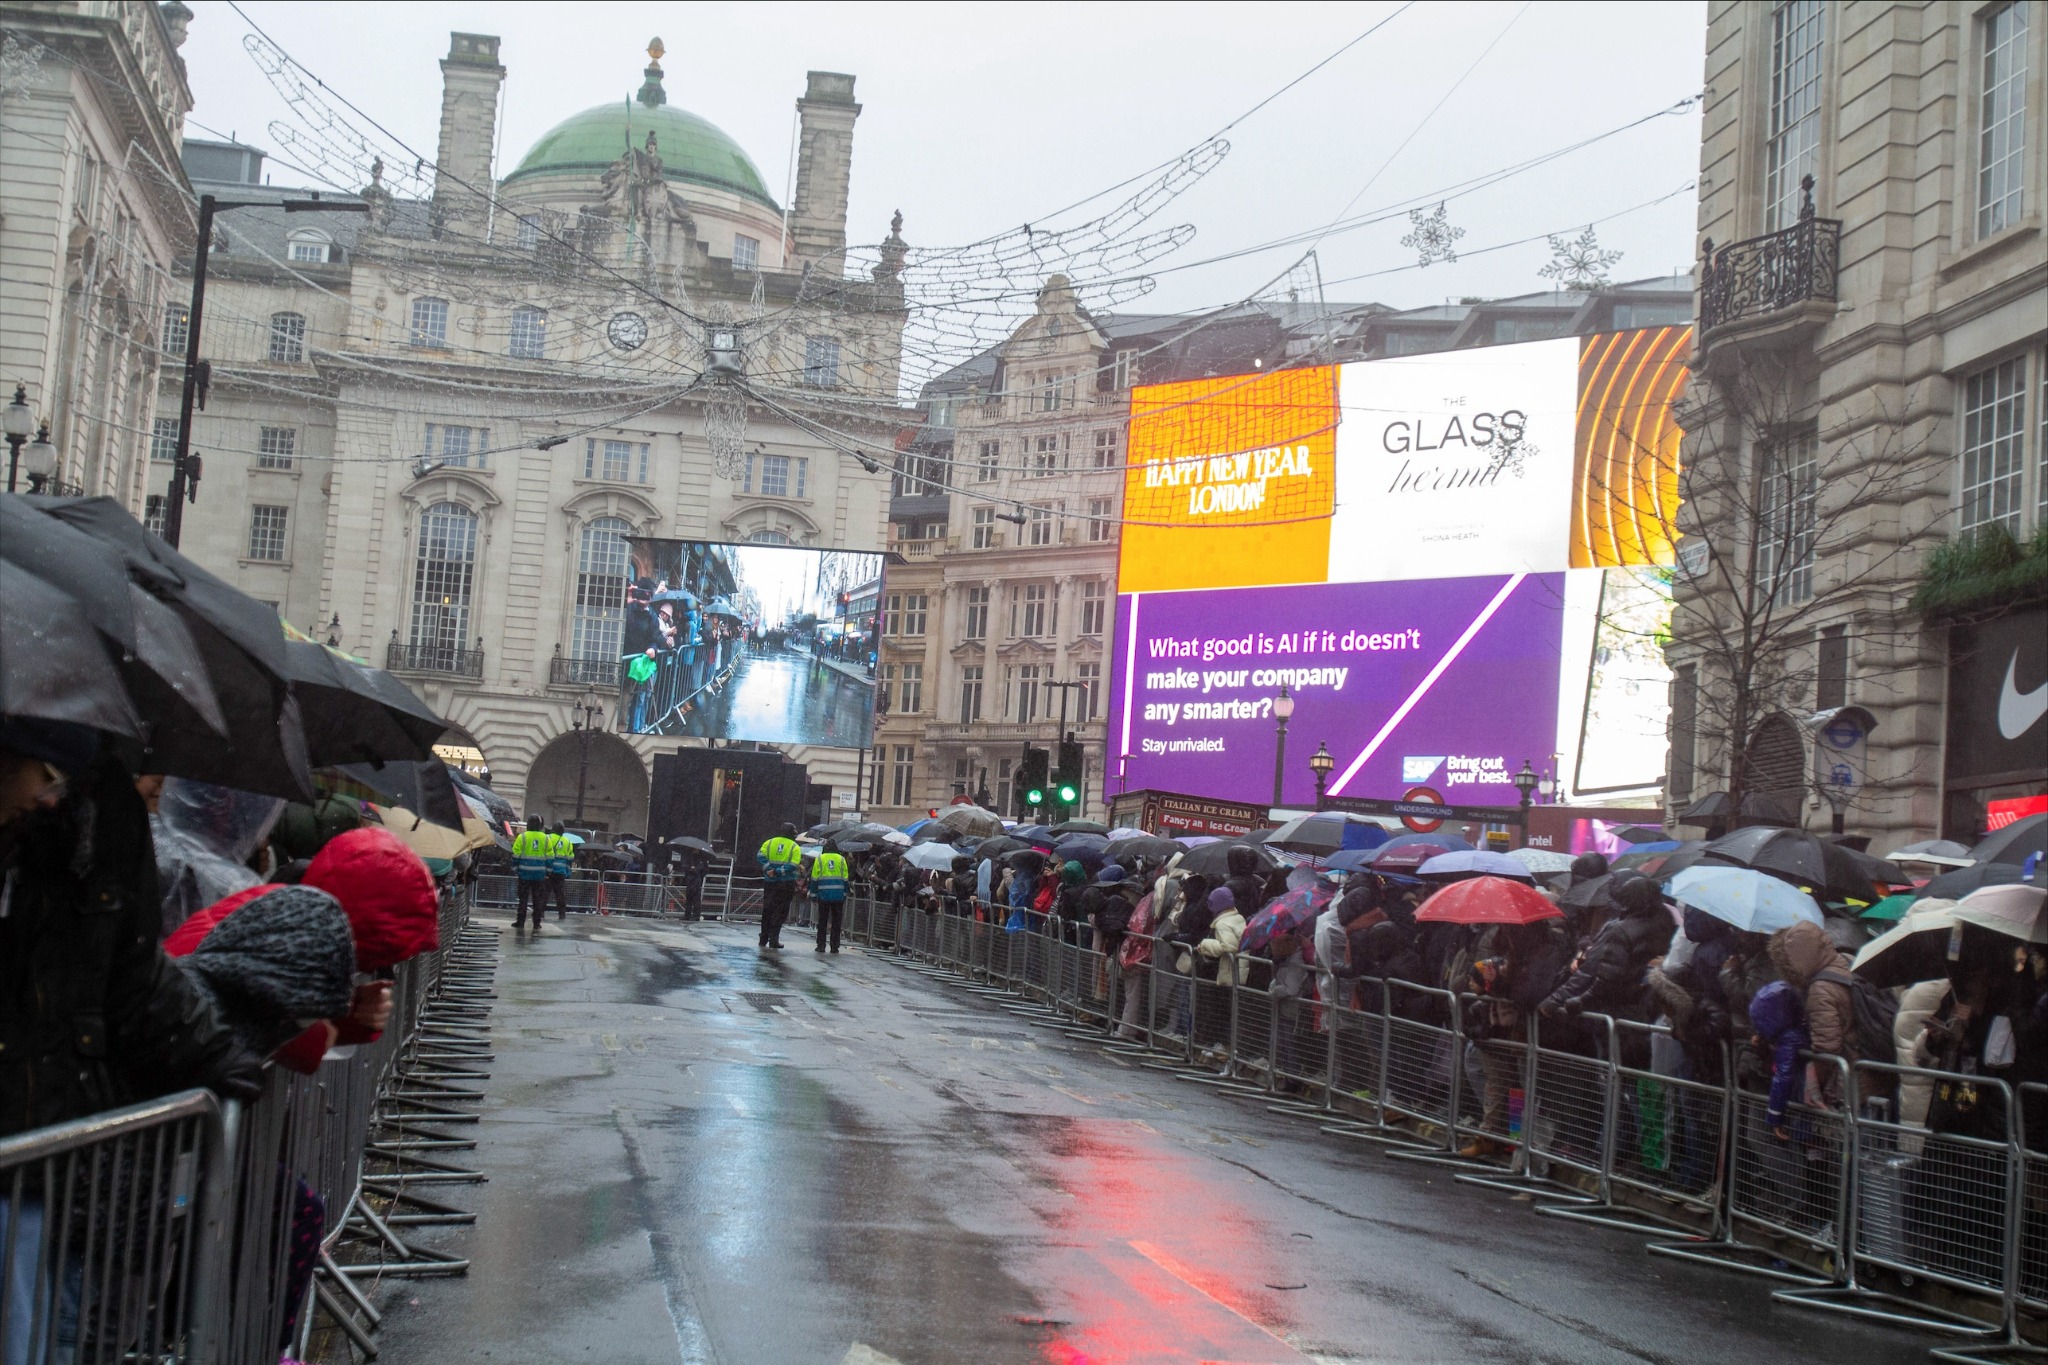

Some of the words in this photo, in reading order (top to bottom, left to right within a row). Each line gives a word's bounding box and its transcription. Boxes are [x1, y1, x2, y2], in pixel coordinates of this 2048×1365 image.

[1443, 396, 1467, 407] THE
[1383, 409, 1525, 454] GLASS
[1145, 454, 1207, 488] HAPPY
[1208, 451, 1251, 483] NEW
[1254, 445, 1313, 478] YEAR,
[1188, 474, 1267, 515] LONDON!
[1422, 534, 1450, 543] SHONA
[1452, 532, 1479, 541] HEATH
[1149, 637, 1199, 657] What
[1202, 634, 1253, 661] good
[1258, 632, 1274, 654] is
[1277, 633, 1298, 653] AI
[1303, 630, 1318, 653] if
[1321, 630, 1336, 652] it
[1340, 628, 1420, 651] doesn't
[1146, 667, 1199, 689] make
[1202, 670, 1249, 693] your
[1252, 667, 1348, 691] company
[1144, 703, 1180, 725] any
[1182, 697, 1273, 719] smarter?
[1141, 738, 1167, 755] Stay
[1169, 737, 1225, 752] unrivaled.
[1403, 760, 1436, 778] SAP
[1447, 755, 1481, 772] Bring
[1481, 756, 1504, 770] out
[1447, 771, 1478, 787] your
[1478, 769, 1512, 784] best.
[1164, 800, 1202, 813] ITALIAN
[1203, 805, 1217, 814] ICE
[1219, 807, 1251, 818] CREAM
[1336, 800, 1354, 808] PUBLIC
[1394, 804, 1453, 816] UNDERGROUND
[1163, 814, 1191, 829] Fancy
[1192, 819, 1203, 828] an
[1209, 820, 1223, 831] Ice
[1223, 823, 1251, 834] Cream
[1528, 834, 1553, 846] intel
